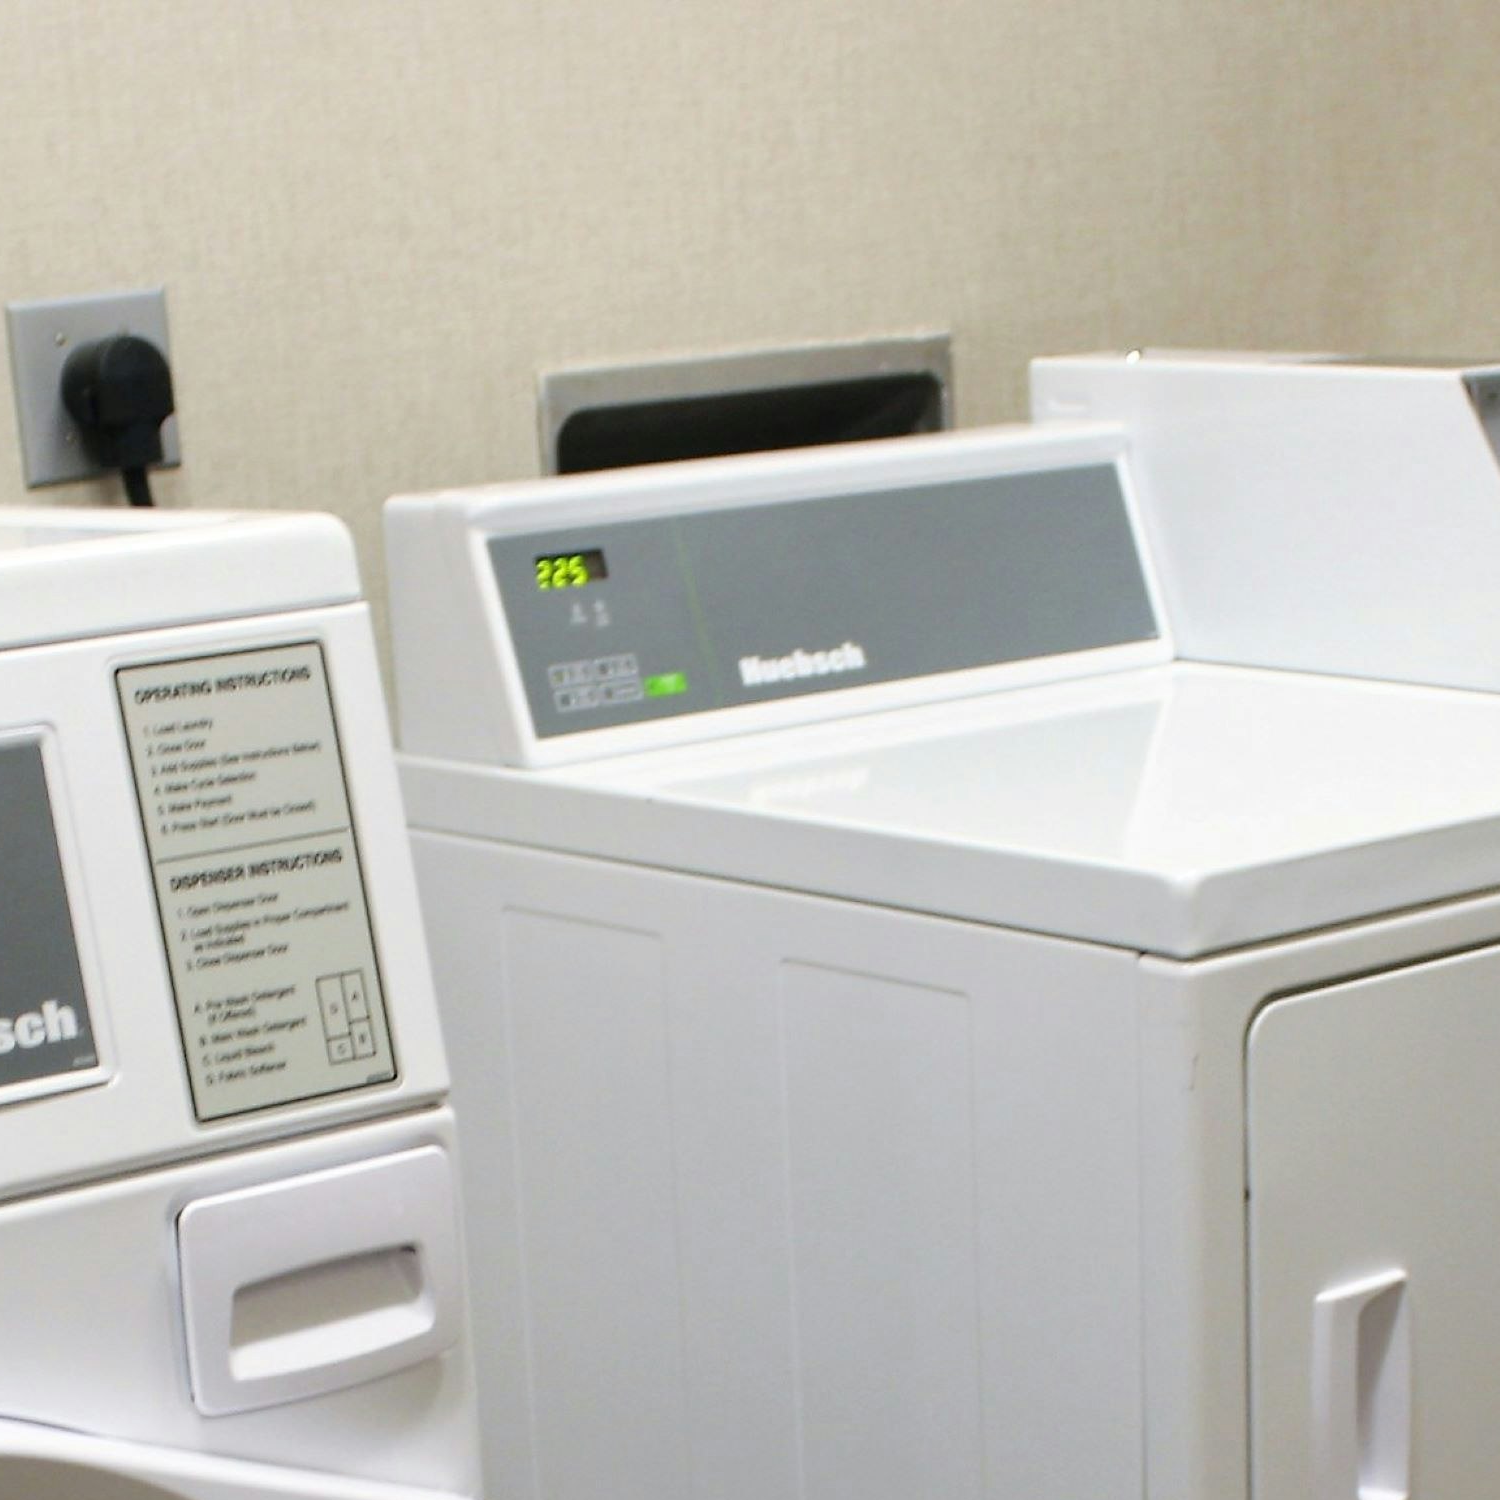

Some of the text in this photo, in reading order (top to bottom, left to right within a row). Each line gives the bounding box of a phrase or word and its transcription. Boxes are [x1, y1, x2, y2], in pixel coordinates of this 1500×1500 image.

[135, 667, 310, 703] OPERATING INSTRUCTIONS
[171, 849, 342, 890] DISPENSER INSTRUCTIONS
